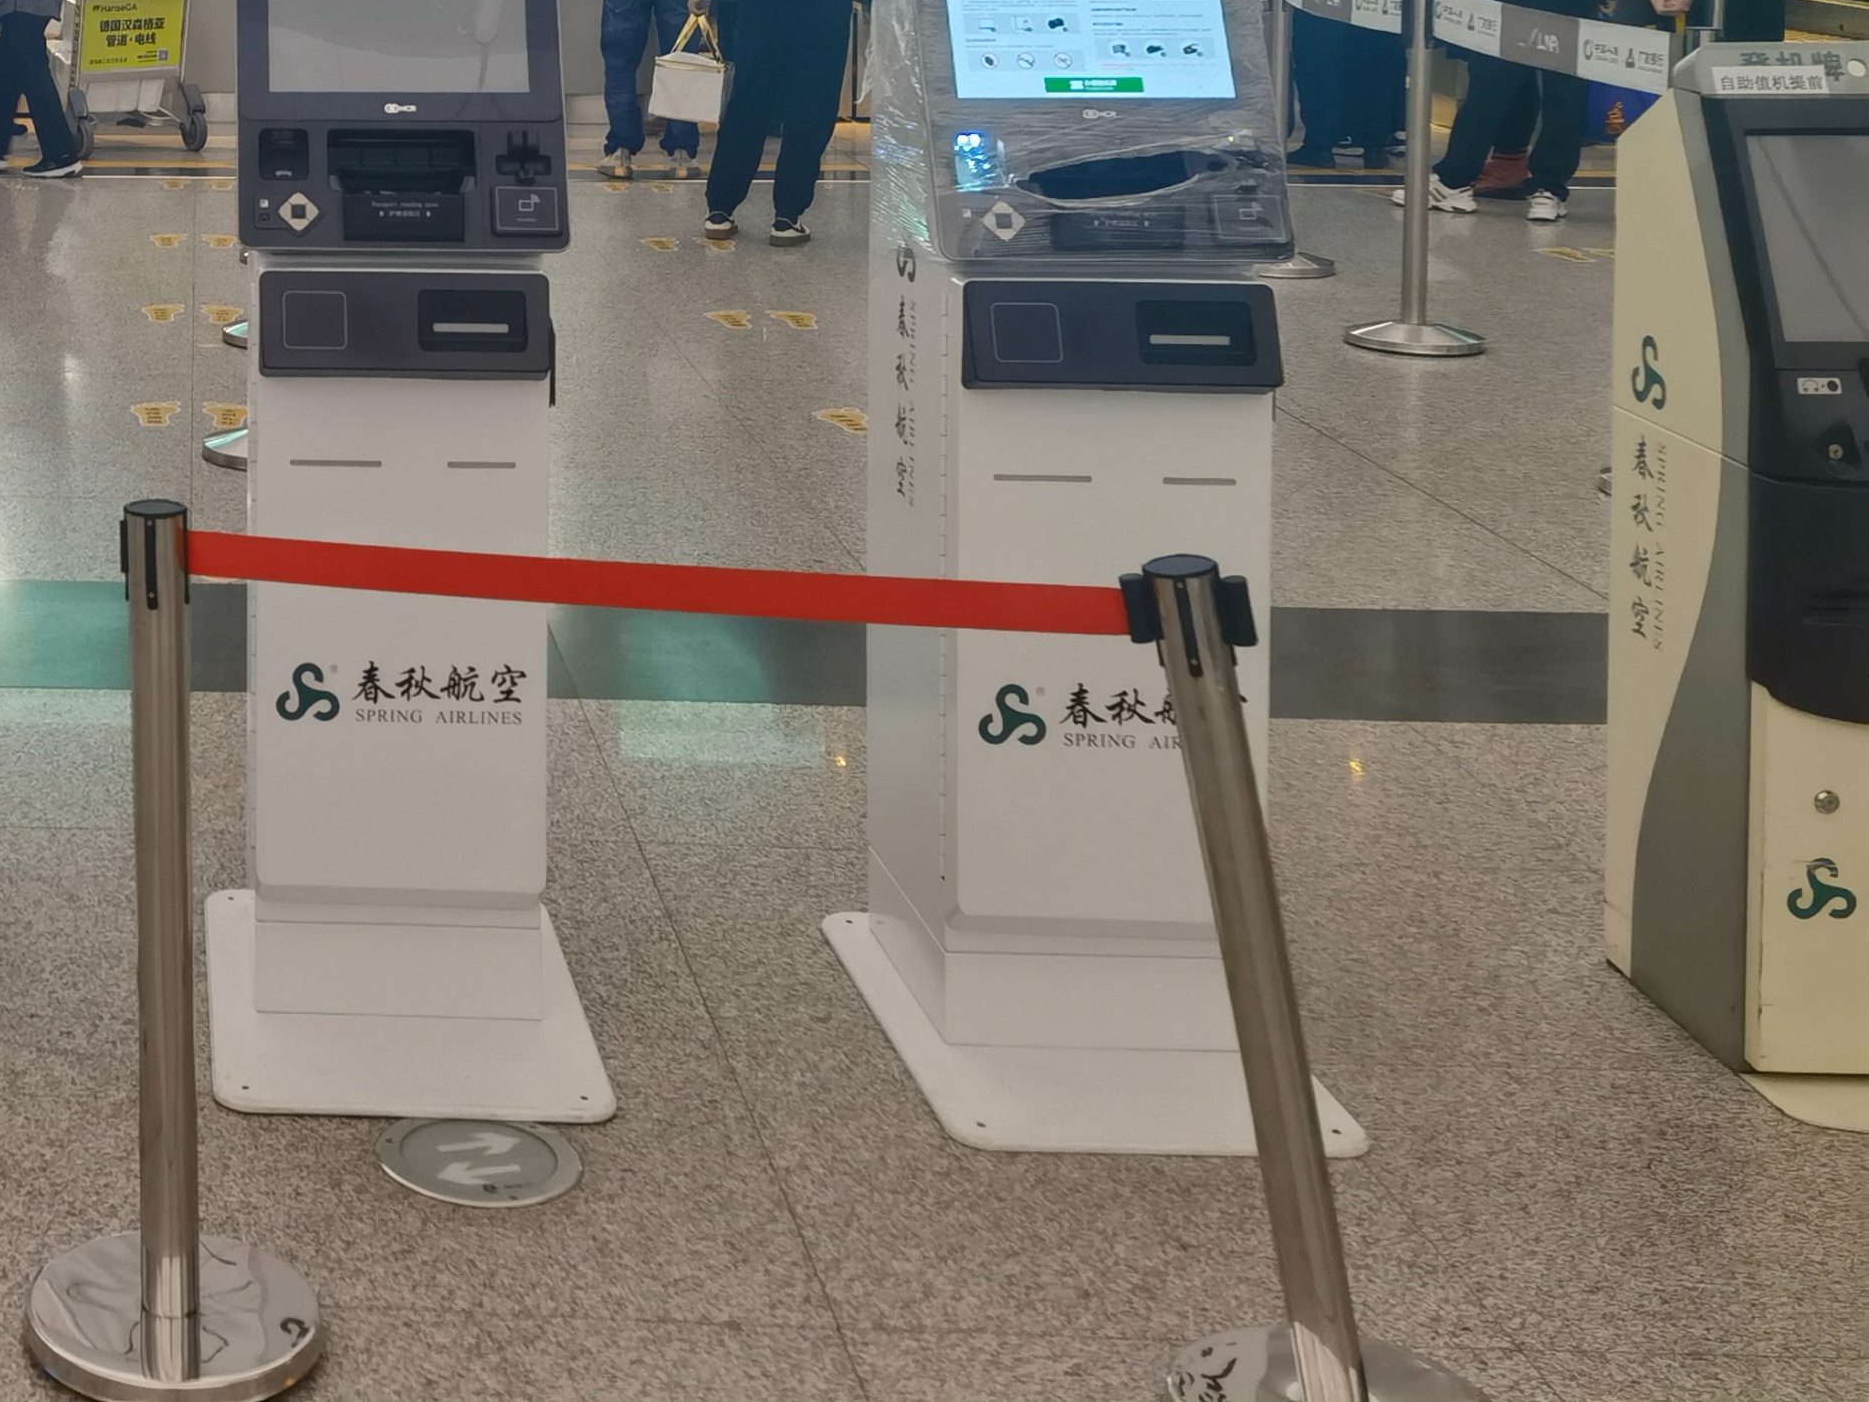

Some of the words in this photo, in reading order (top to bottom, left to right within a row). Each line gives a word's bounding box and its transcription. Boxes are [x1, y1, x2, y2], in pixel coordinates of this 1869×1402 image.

[99, 17, 166, 33] 德国汉森格亚
[1720, 75, 1823, 91] 自助值机提前
[1098, 110, 1117, 118] NCR
[1630, 434, 1654, 639] 春秋航空
[352, 661, 527, 705] 春秋航空
[1059, 682, 1178, 729] 春秋
[355, 708, 423, 724] SPRING
[435, 710, 522, 725] AIRLINES
[1063, 732, 1136, 750] SPRING
